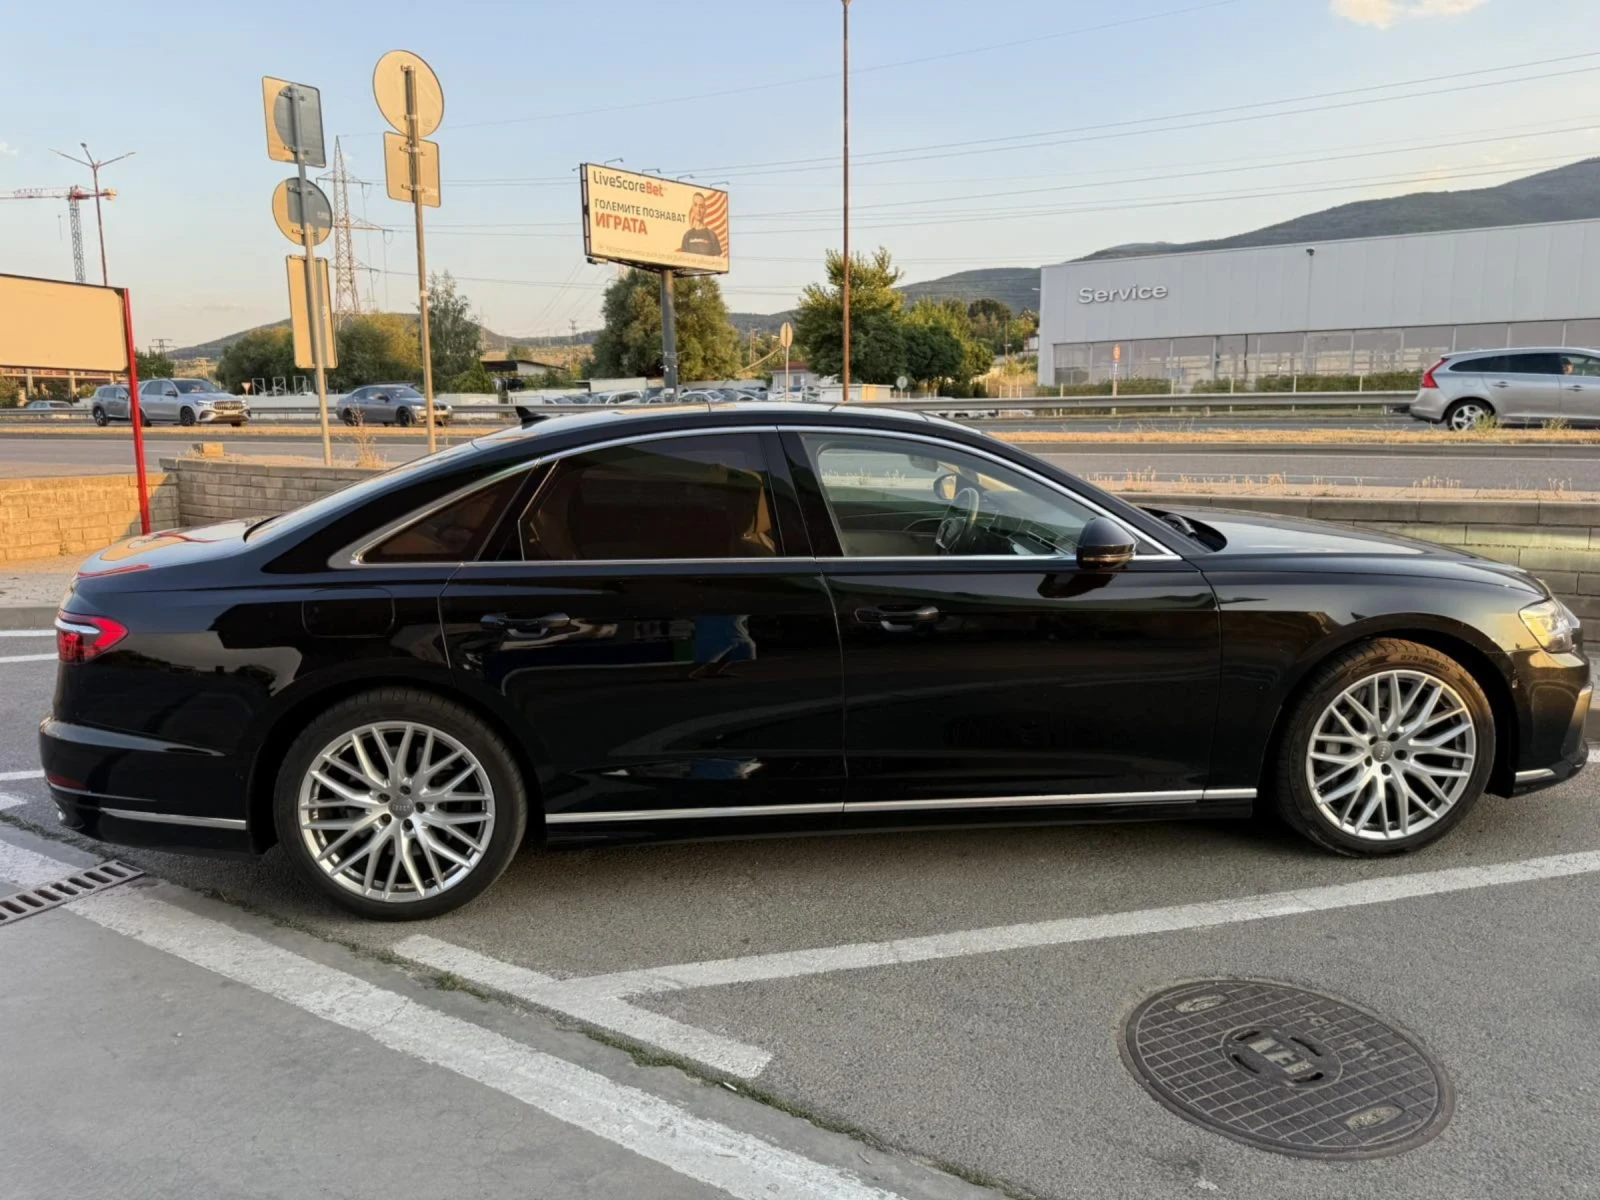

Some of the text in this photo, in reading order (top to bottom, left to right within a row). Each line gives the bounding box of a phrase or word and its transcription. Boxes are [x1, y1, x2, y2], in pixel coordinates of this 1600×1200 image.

[593, 170, 664, 197] LiveScoreBet
[594, 198, 686, 223] ГОЛЕМИТЕ ПОЗНАВАТ
[595, 211, 648, 235] ИГРАТА
[1079, 284, 1168, 304] Service
